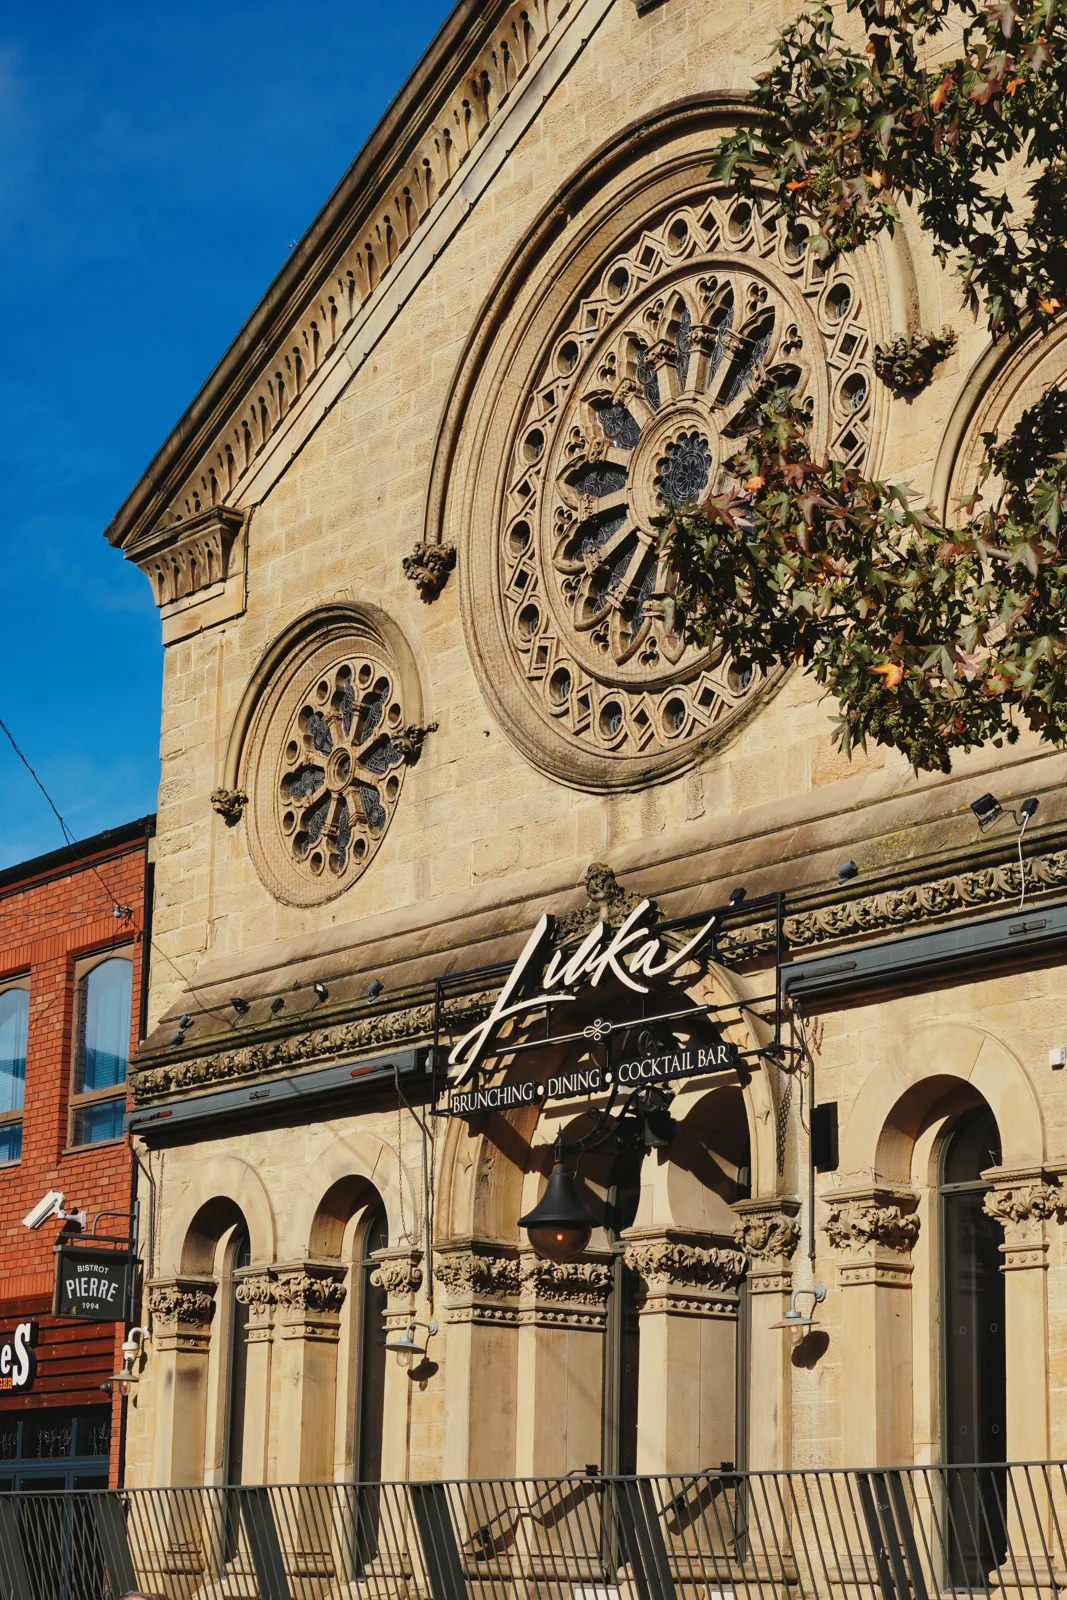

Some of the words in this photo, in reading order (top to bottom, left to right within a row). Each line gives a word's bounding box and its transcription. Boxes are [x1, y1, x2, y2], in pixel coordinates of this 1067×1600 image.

[452, 1082, 533, 1114] BRUNCHING
[547, 1069, 601, 1097] DINING
[618, 1052, 694, 1082] COCKTAIL
[697, 1045, 729, 1067] BAR
[77, 1264, 109, 1275] BISTROT
[66, 1278, 118, 1302] PIERRE
[82, 1302, 99, 1310] 1994
